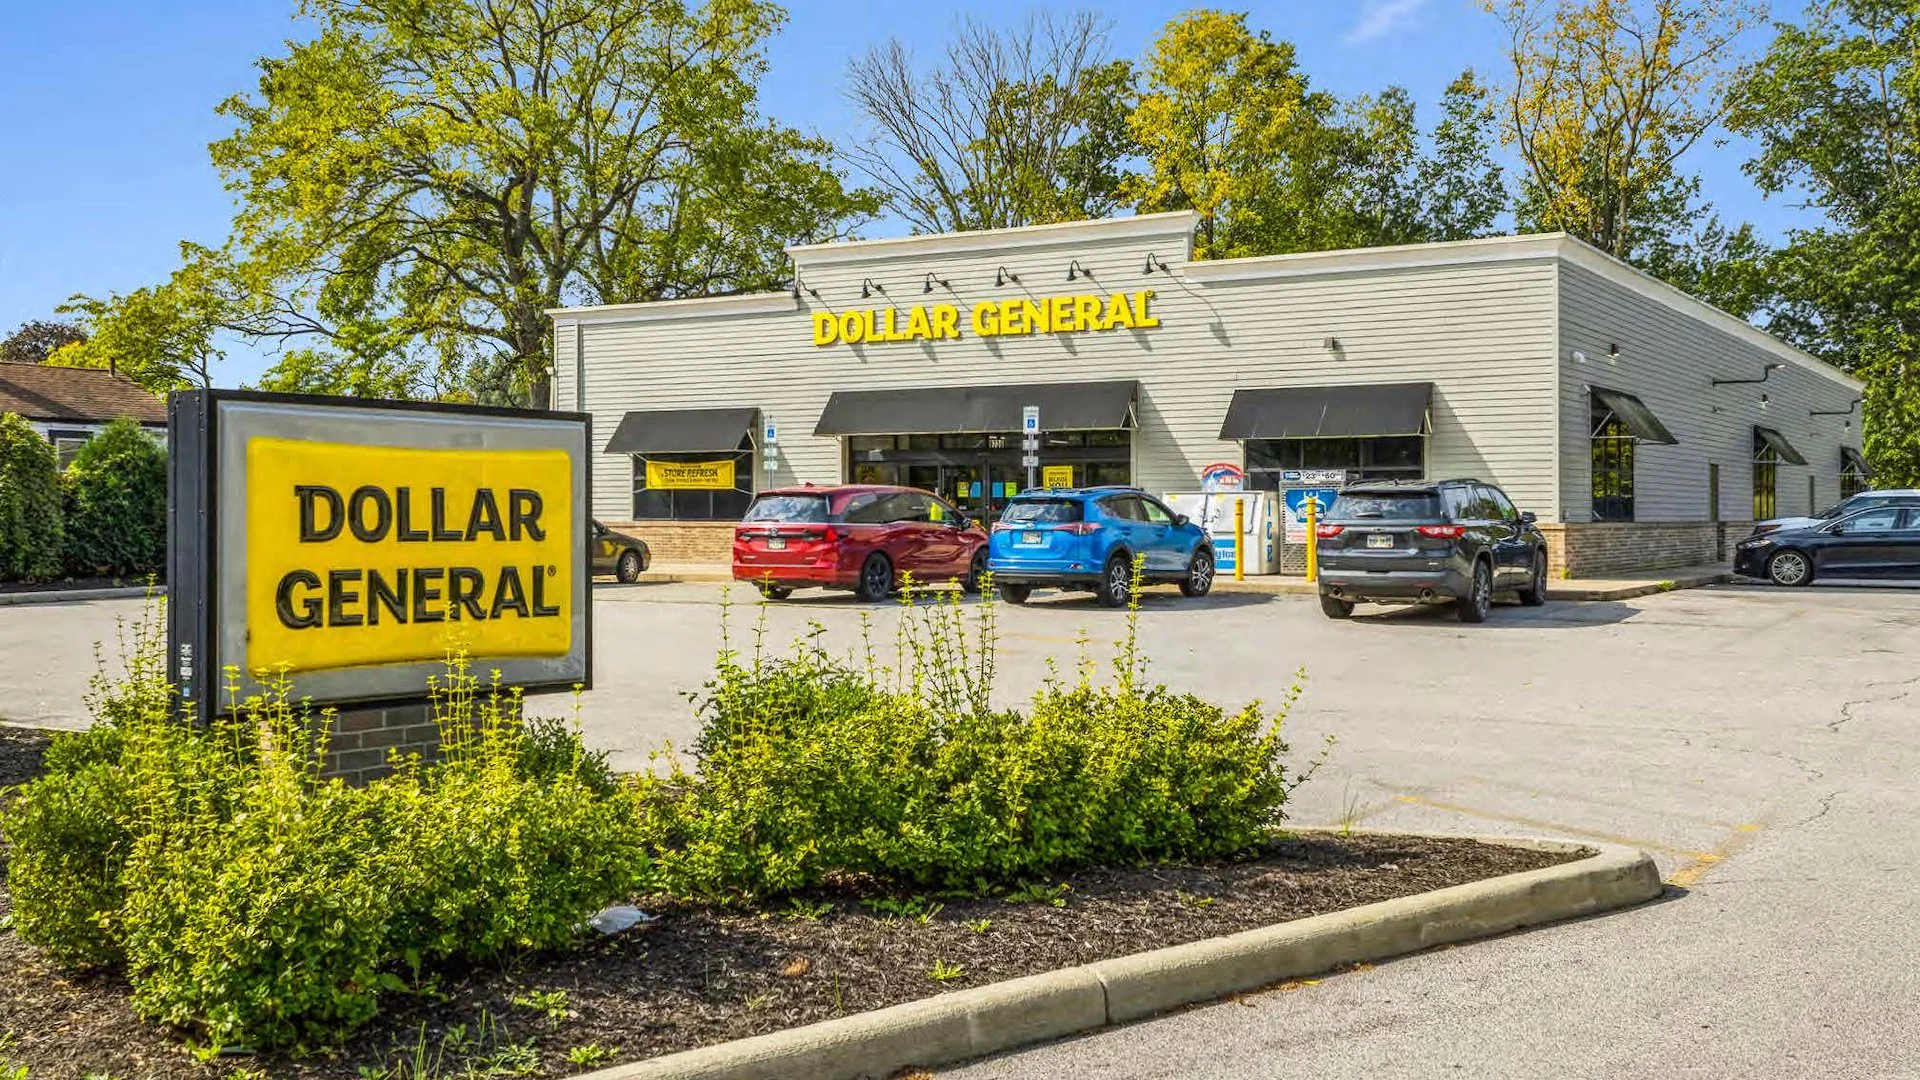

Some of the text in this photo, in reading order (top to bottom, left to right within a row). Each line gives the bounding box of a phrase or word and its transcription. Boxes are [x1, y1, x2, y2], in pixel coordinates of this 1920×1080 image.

[813, 304, 960, 346] DOLLAR
[664, 468, 718, 478] STORE REFRESH
[294, 484, 546, 544] DOLLAR
